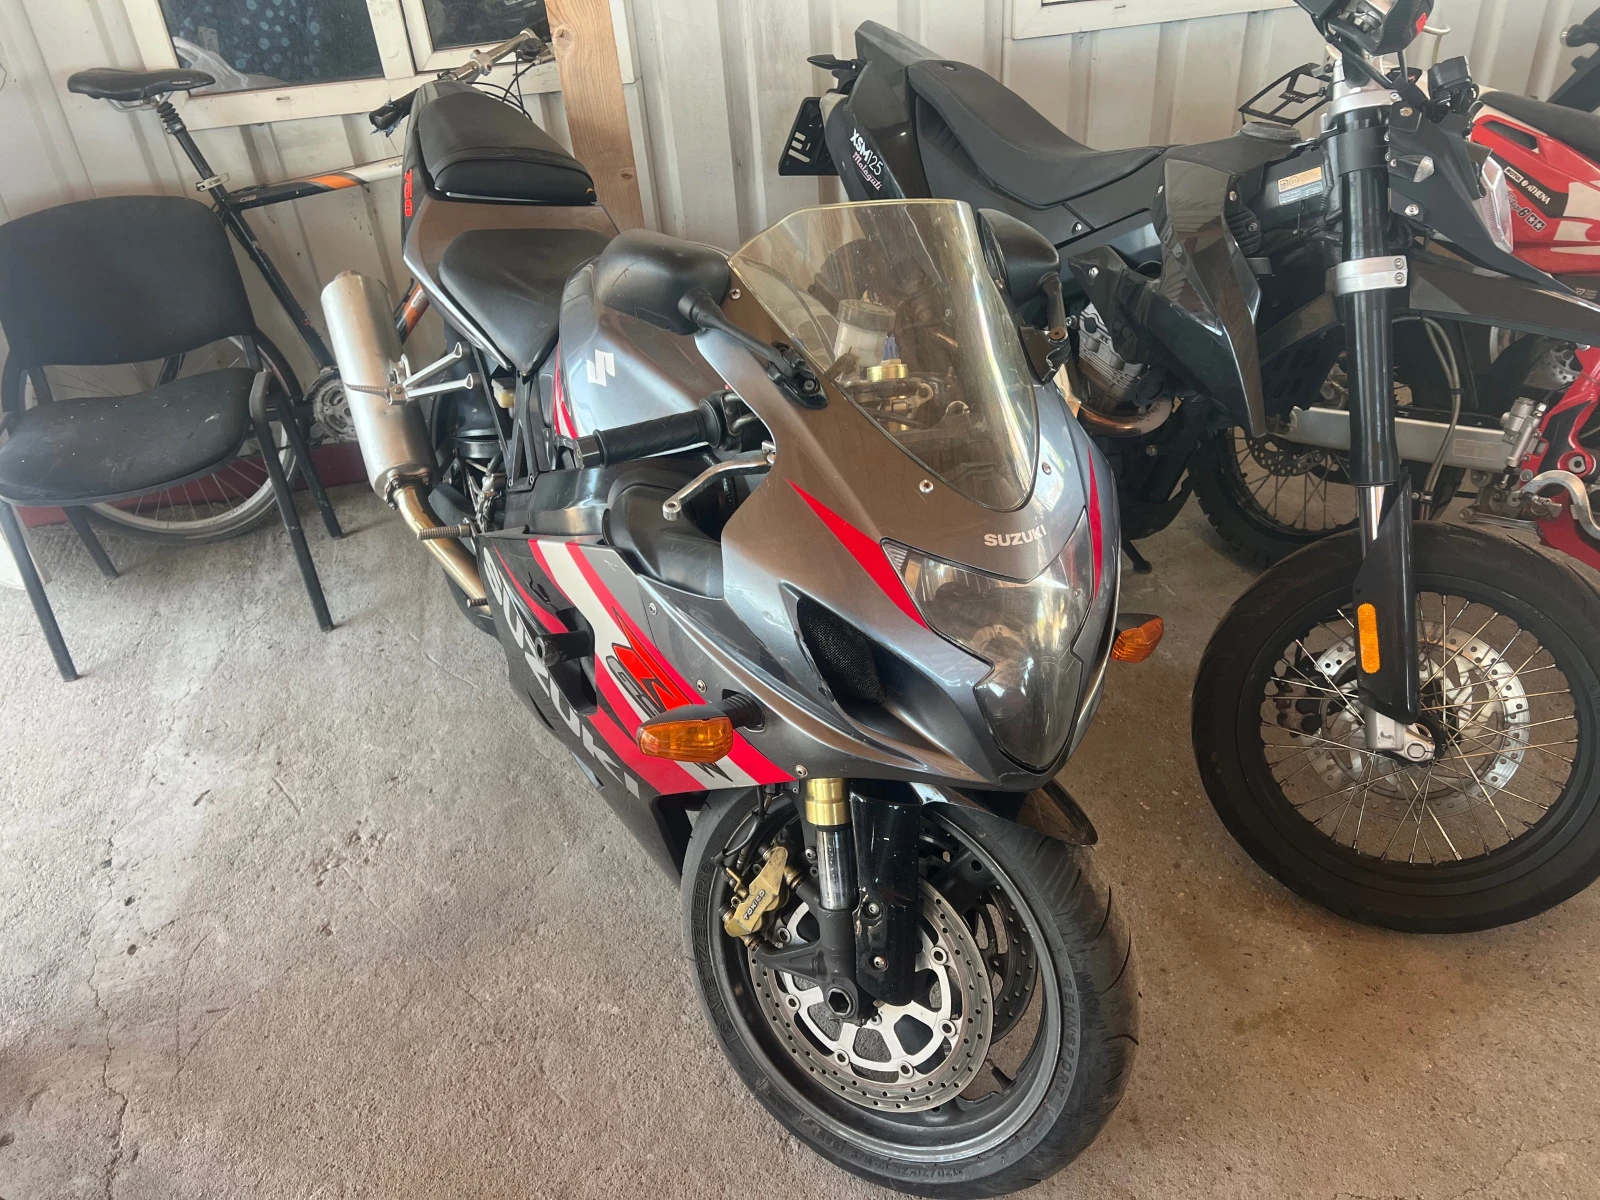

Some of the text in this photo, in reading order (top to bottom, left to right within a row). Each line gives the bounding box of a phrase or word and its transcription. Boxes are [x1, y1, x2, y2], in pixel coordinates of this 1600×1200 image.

[403, 168, 413, 217] 750
[852, 152, 883, 191] Malaguti
[1525, 184, 1551, 205] ATHENA
[983, 523, 1047, 547] SUZUKI
[483, 546, 641, 800] SUZUKI
[743, 889, 766, 920] TOKICO
[691, 881, 725, 1015] METZELER
[1055, 976, 1078, 1098] RENNSPORT
